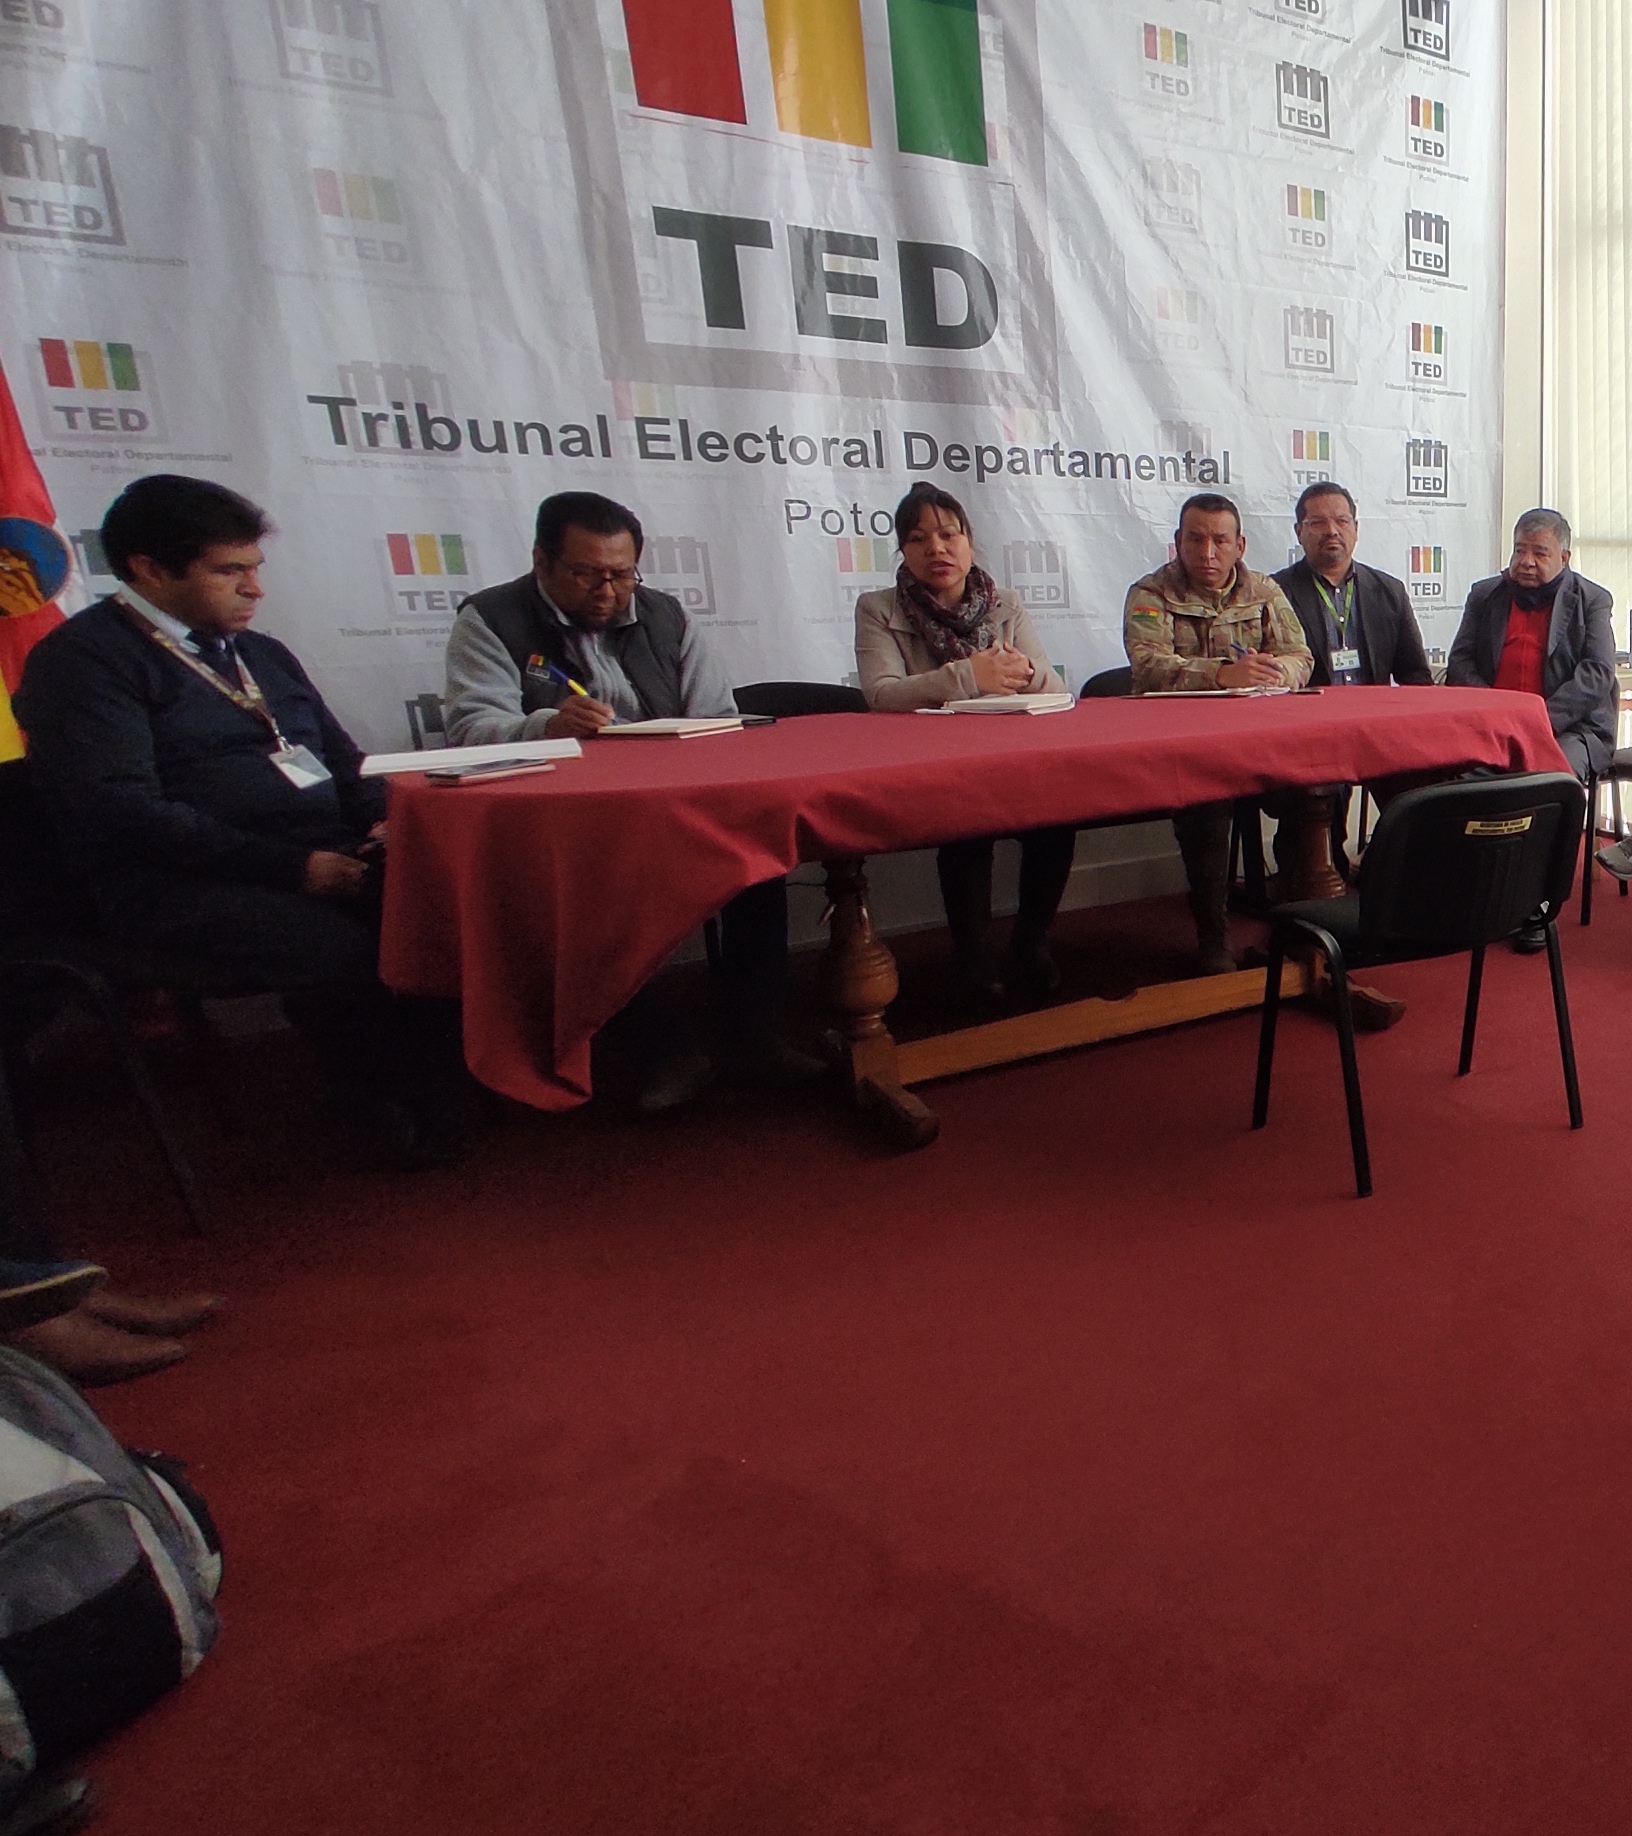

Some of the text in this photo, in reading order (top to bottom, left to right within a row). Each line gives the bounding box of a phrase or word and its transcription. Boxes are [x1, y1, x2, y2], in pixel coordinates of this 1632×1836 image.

[0, 0, 65, 28] ED
[1410, 27, 1443, 51] TED
[290, 45, 375, 82] TED
[1145, 71, 1189, 96] TED
[1284, 105, 1322, 129] TED
[1410, 137, 1444, 157] TED
[8, 196, 103, 230] TED
[323, 232, 408, 264] TED
[1288, 227, 1325, 247] TED
[1412, 250, 1443, 269] TED
[652, 206, 998, 350] TED
[1158, 331, 1199, 351] TED
[1292, 347, 1327, 365] TED
[1412, 361, 1442, 378] TED
[54, 404, 149, 432] TED
[306, 395, 1231, 485] Tribunal Electoral Departamental
[1412, 476, 1442, 490] TED
[784, 499, 894, 536] Poto
[1015, 585, 1060, 601] TED
[1411, 582, 1441, 596] TED
